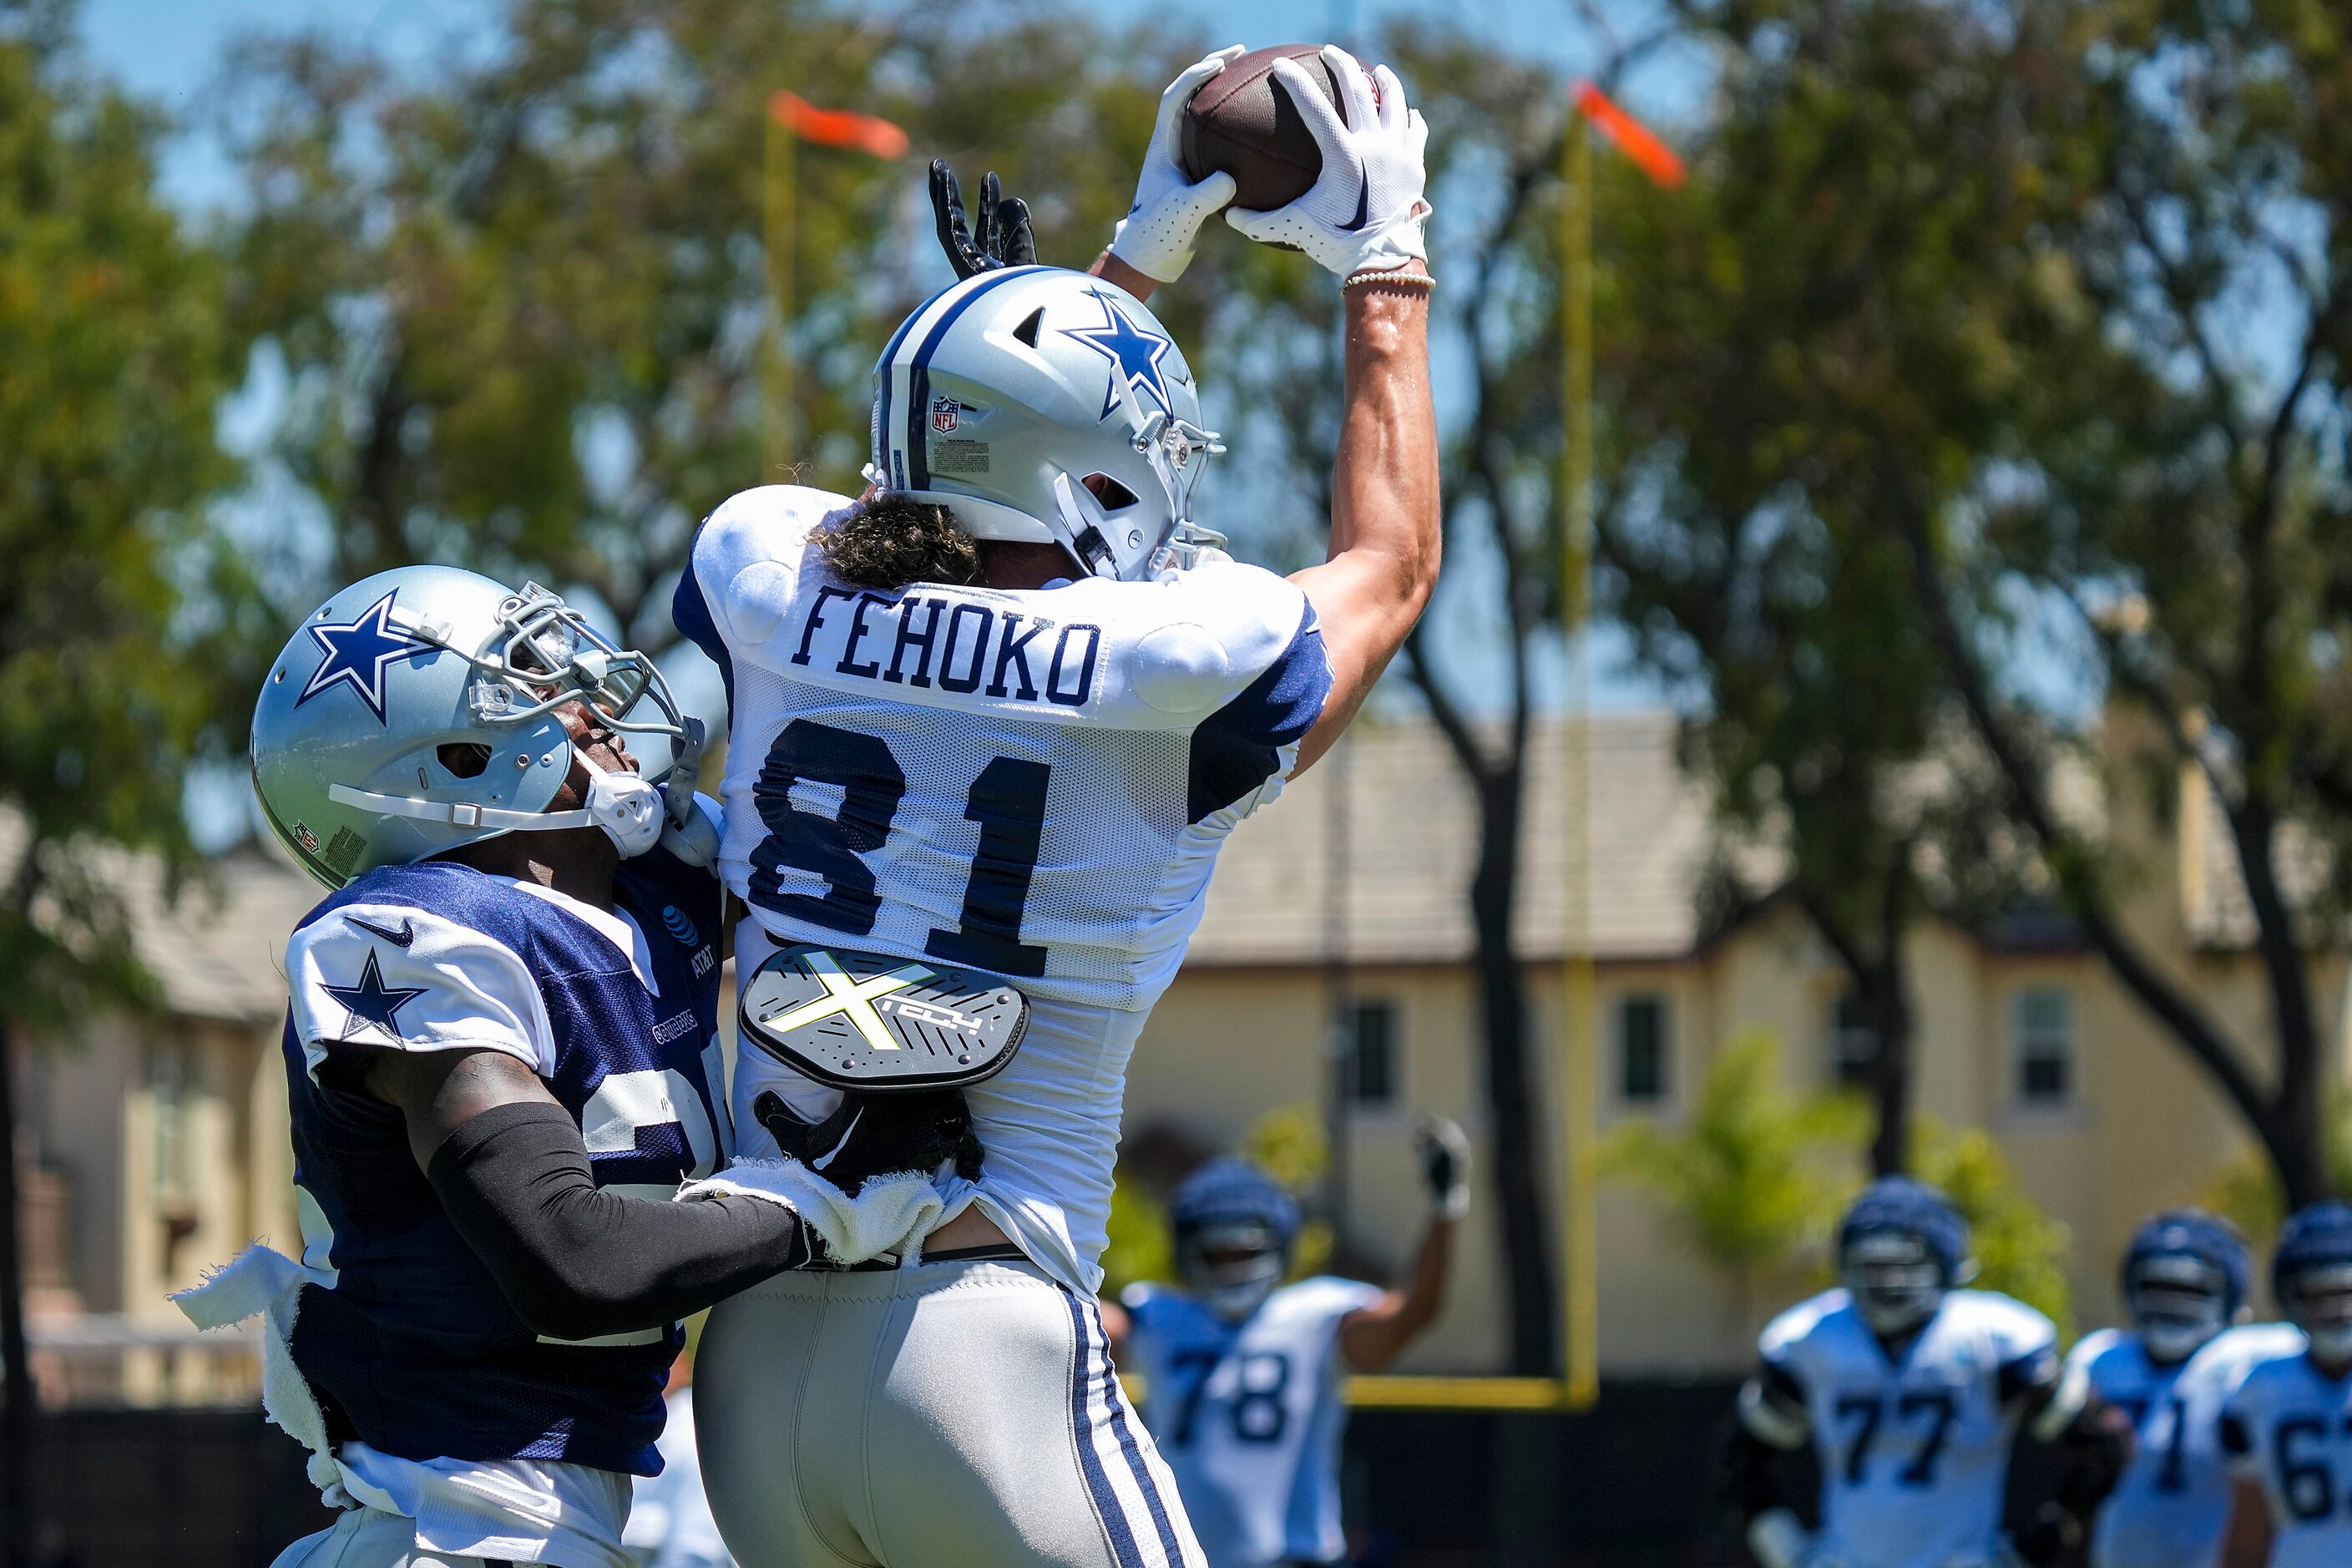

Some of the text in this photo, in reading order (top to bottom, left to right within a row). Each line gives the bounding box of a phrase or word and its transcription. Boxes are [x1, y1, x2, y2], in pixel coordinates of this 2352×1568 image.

[934, 412, 954, 429] NFL
[790, 586, 1102, 706] FEHOKO
[748, 718, 1050, 977] 81
[690, 944, 714, 979] AT&T
[652, 1009, 698, 1044] COWBOYS
[1172, 1353, 1288, 1444] 78
[1834, 1389, 1952, 1485] 77
[2274, 1413, 2352, 1523] 6
